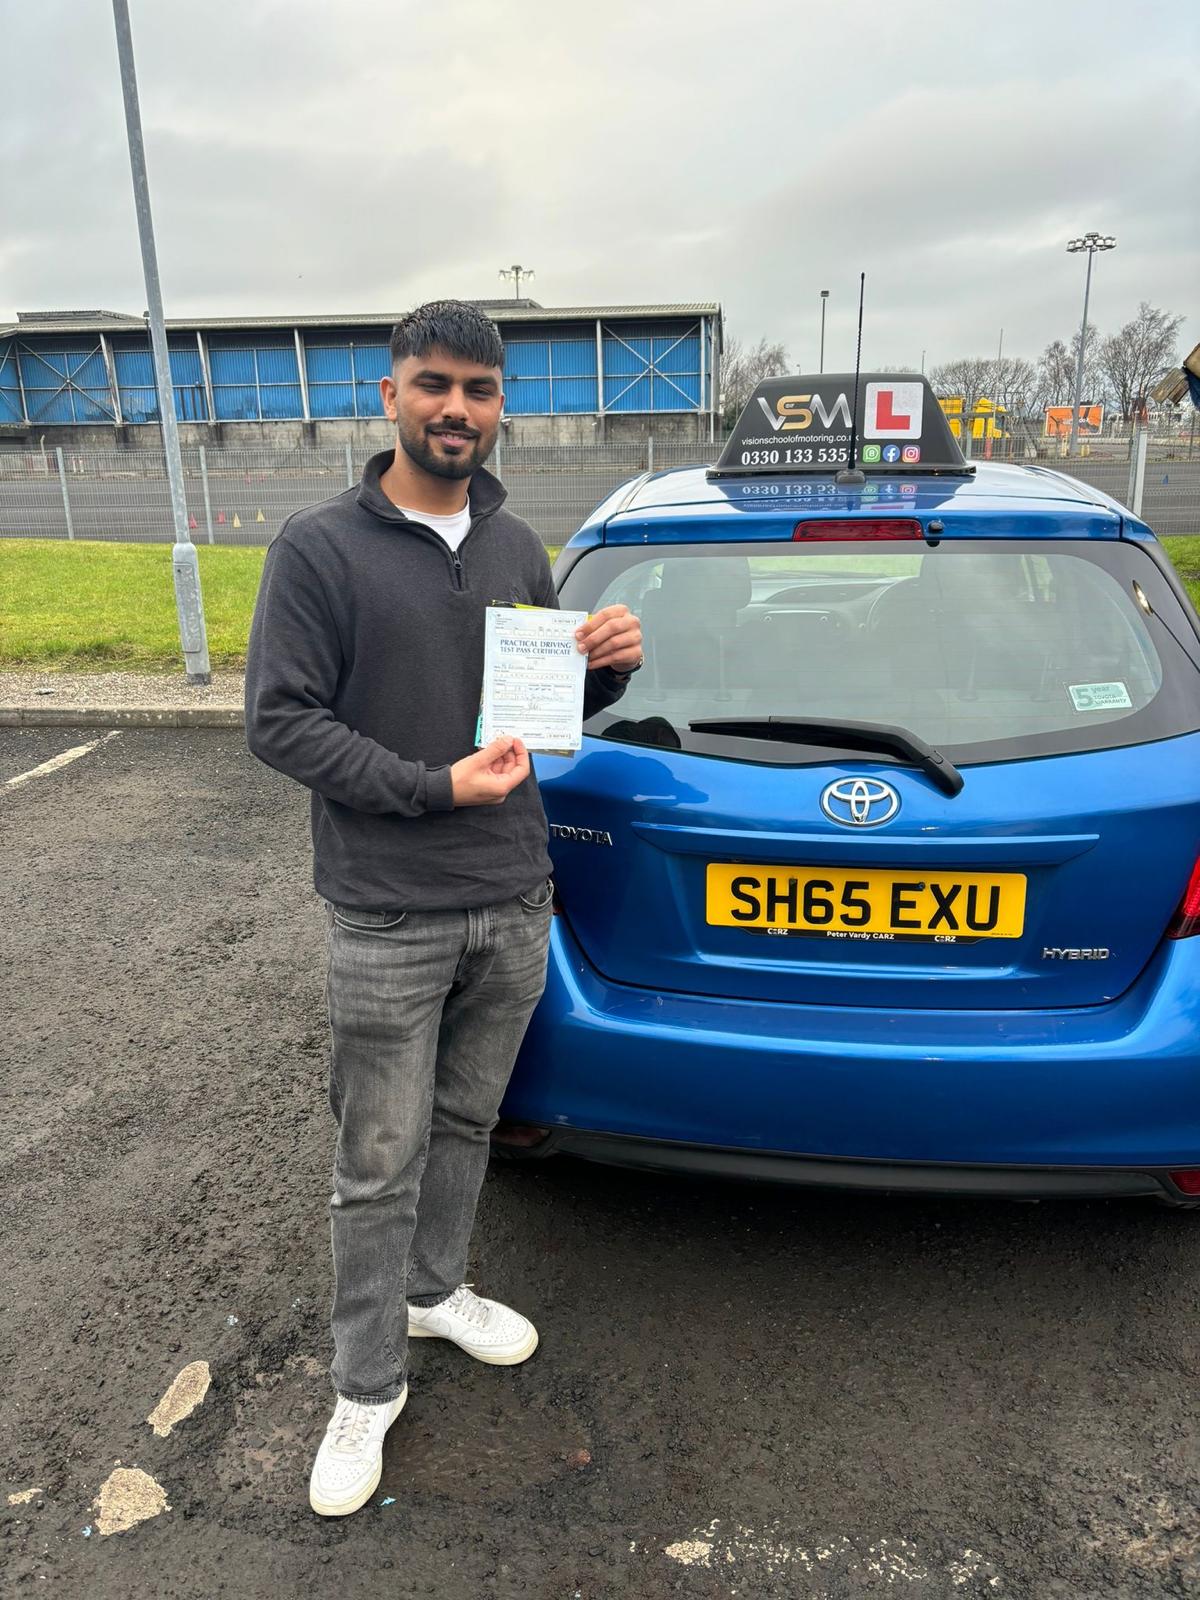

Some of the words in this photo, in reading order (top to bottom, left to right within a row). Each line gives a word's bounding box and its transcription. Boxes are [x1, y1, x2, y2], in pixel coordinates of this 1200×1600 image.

[757, 393, 852, 430] VSM
[876, 391, 910, 430] L
[741, 450, 779, 466] 0330
[785, 448, 813, 464] 133
[500, 639, 537, 648] PRACTICAL
[540, 640, 572, 649] DRIVING
[532, 648, 571, 656] CERTIFICATE
[1075, 688, 1093, 707] 5
[549, 823, 613, 847] TOYOTA
[730, 876, 871, 927] SH65
[890, 882, 1001, 932] EXU
[849, 932, 871, 940] Vardy
[872, 932, 895, 940] CARZ
[1042, 947, 1110, 960] HYBRID
